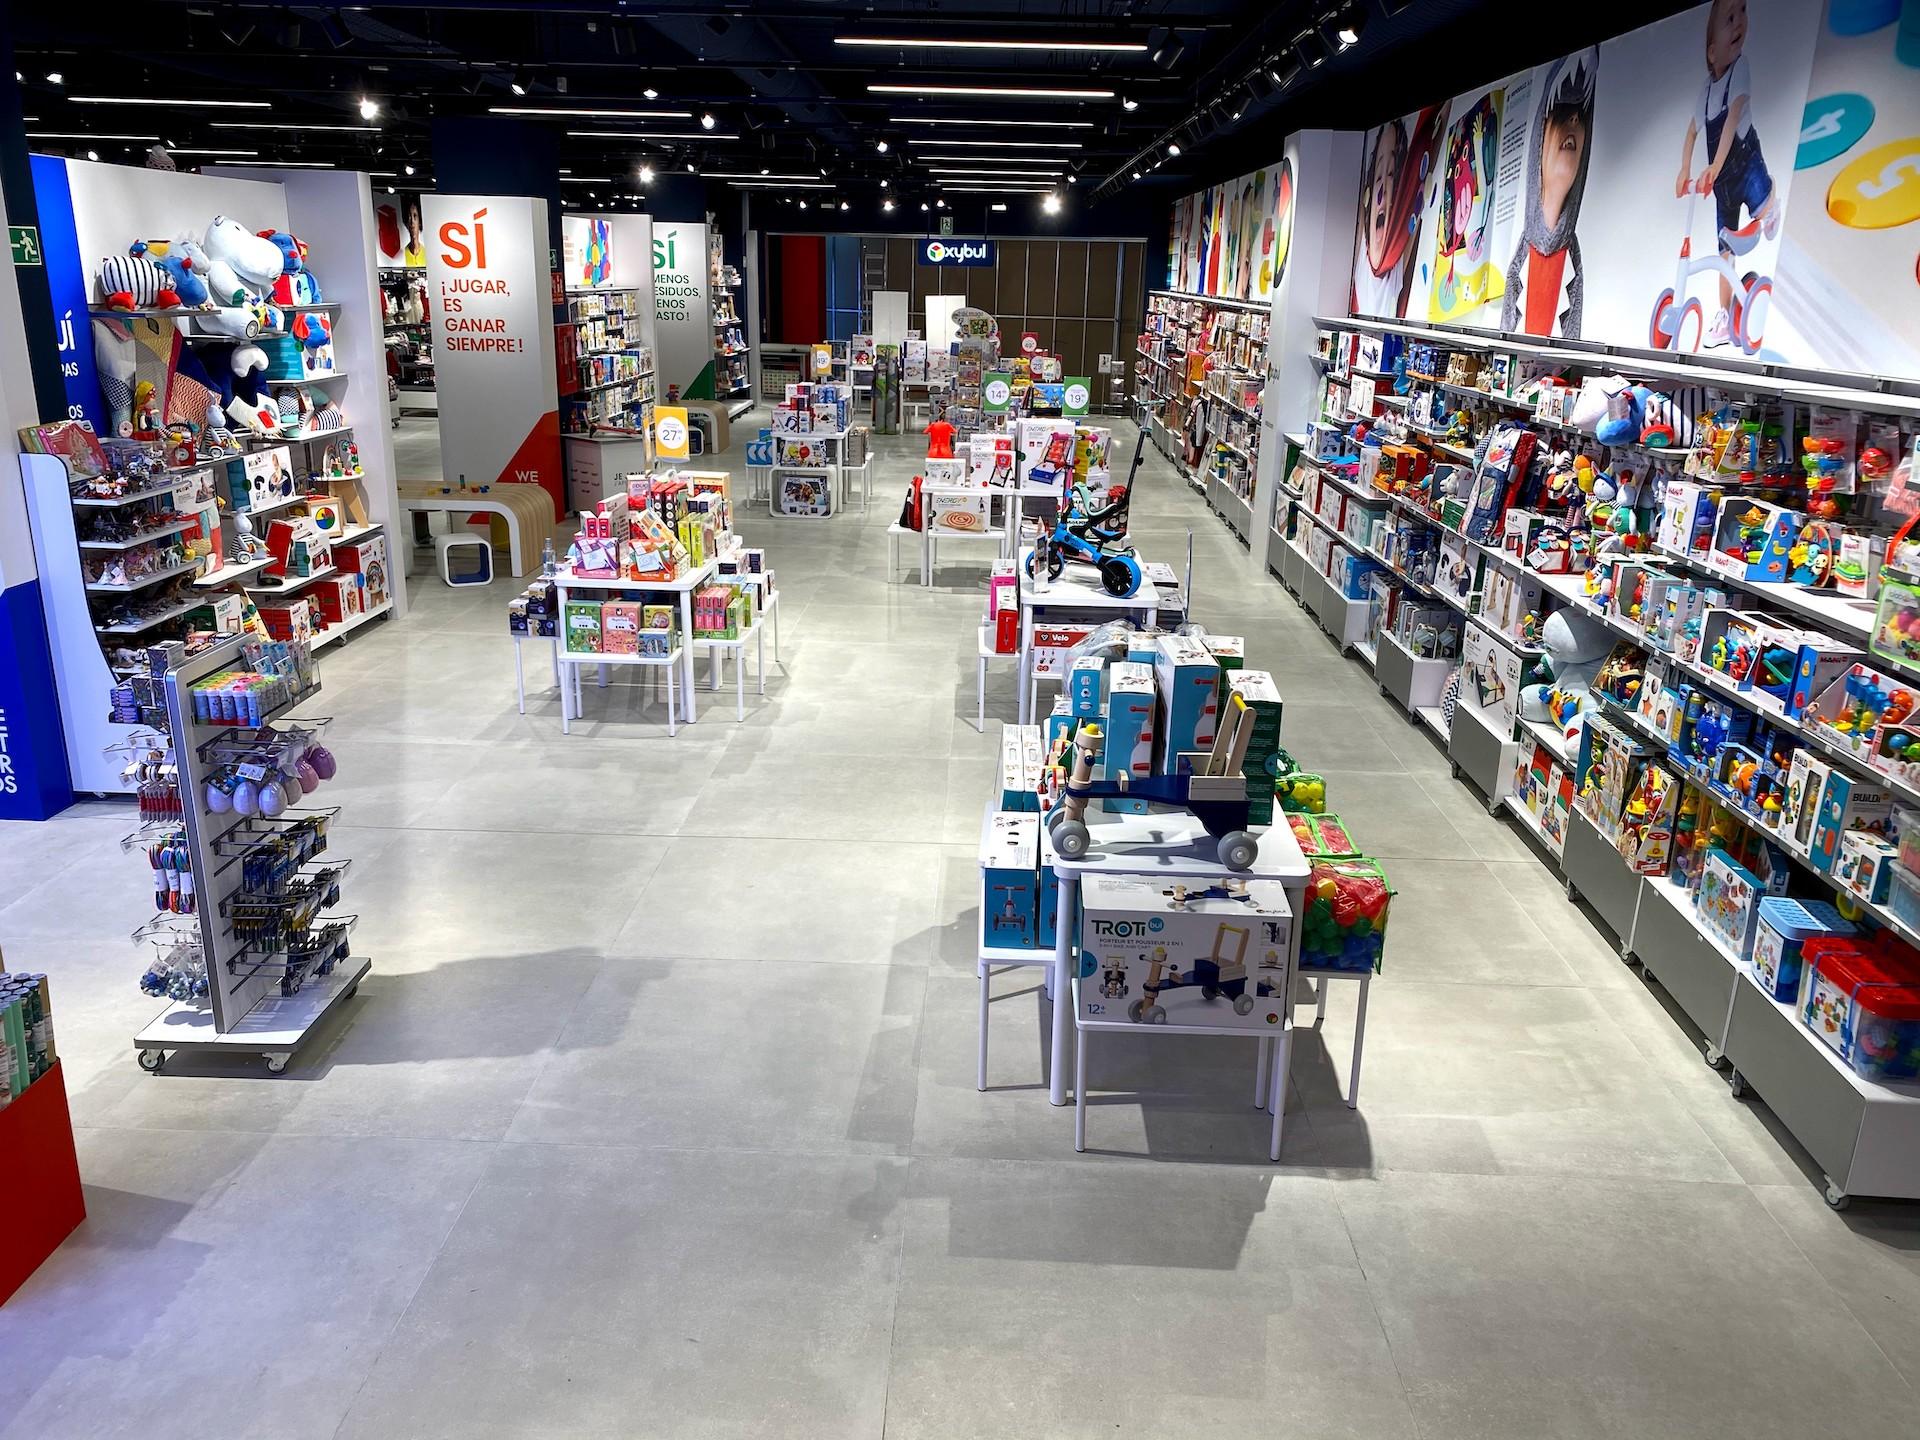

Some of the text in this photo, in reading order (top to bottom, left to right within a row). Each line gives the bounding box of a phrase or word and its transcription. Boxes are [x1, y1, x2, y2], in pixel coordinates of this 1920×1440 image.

[439, 207, 488, 269] SÍ
[927, 241, 987, 263] Oxybul
[444, 298, 462, 312] ES
[656, 299, 685, 308] ENOS
[445, 318, 505, 333] GANAR
[515, 470, 538, 483] WE
[1052, 634, 1069, 642] Velo
